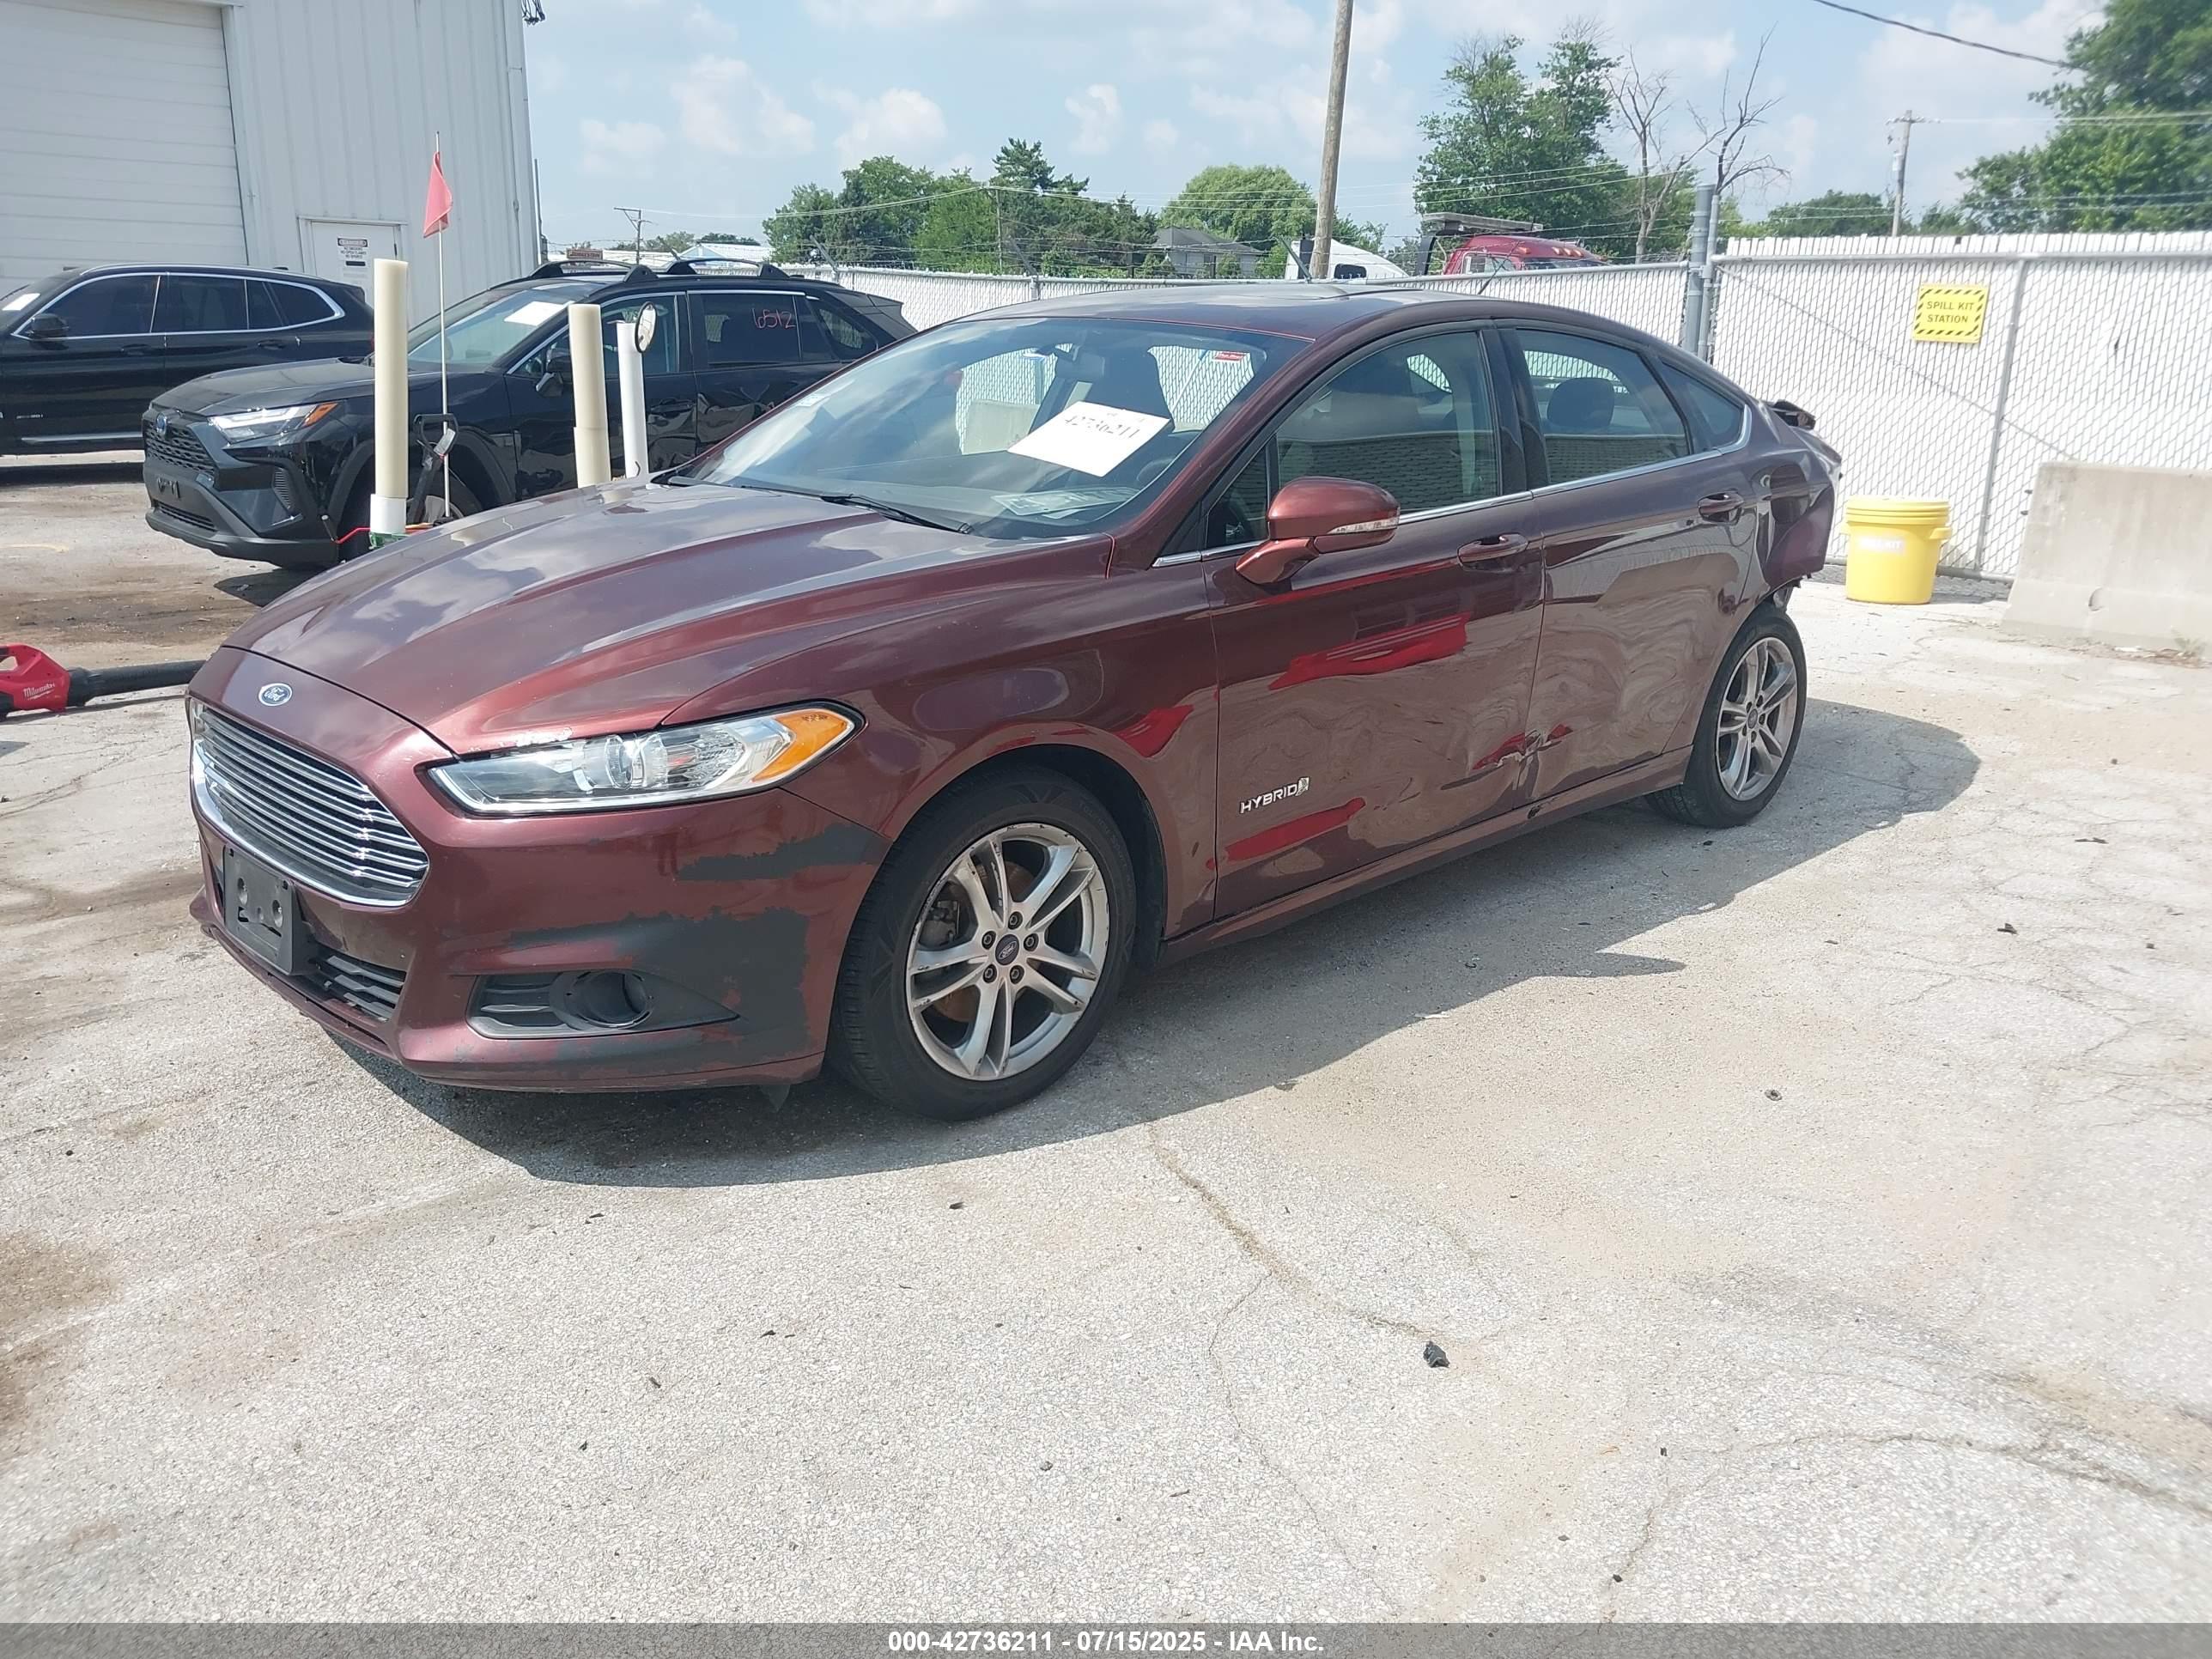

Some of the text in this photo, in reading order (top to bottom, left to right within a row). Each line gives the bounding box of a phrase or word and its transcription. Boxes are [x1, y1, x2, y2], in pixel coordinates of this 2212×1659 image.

[1926, 301, 1974, 310] SPILL KIT
[751, 308, 796, 329] 6512
[1927, 313, 1968, 324] STATION
[1240, 783, 1297, 814] HYBRID
